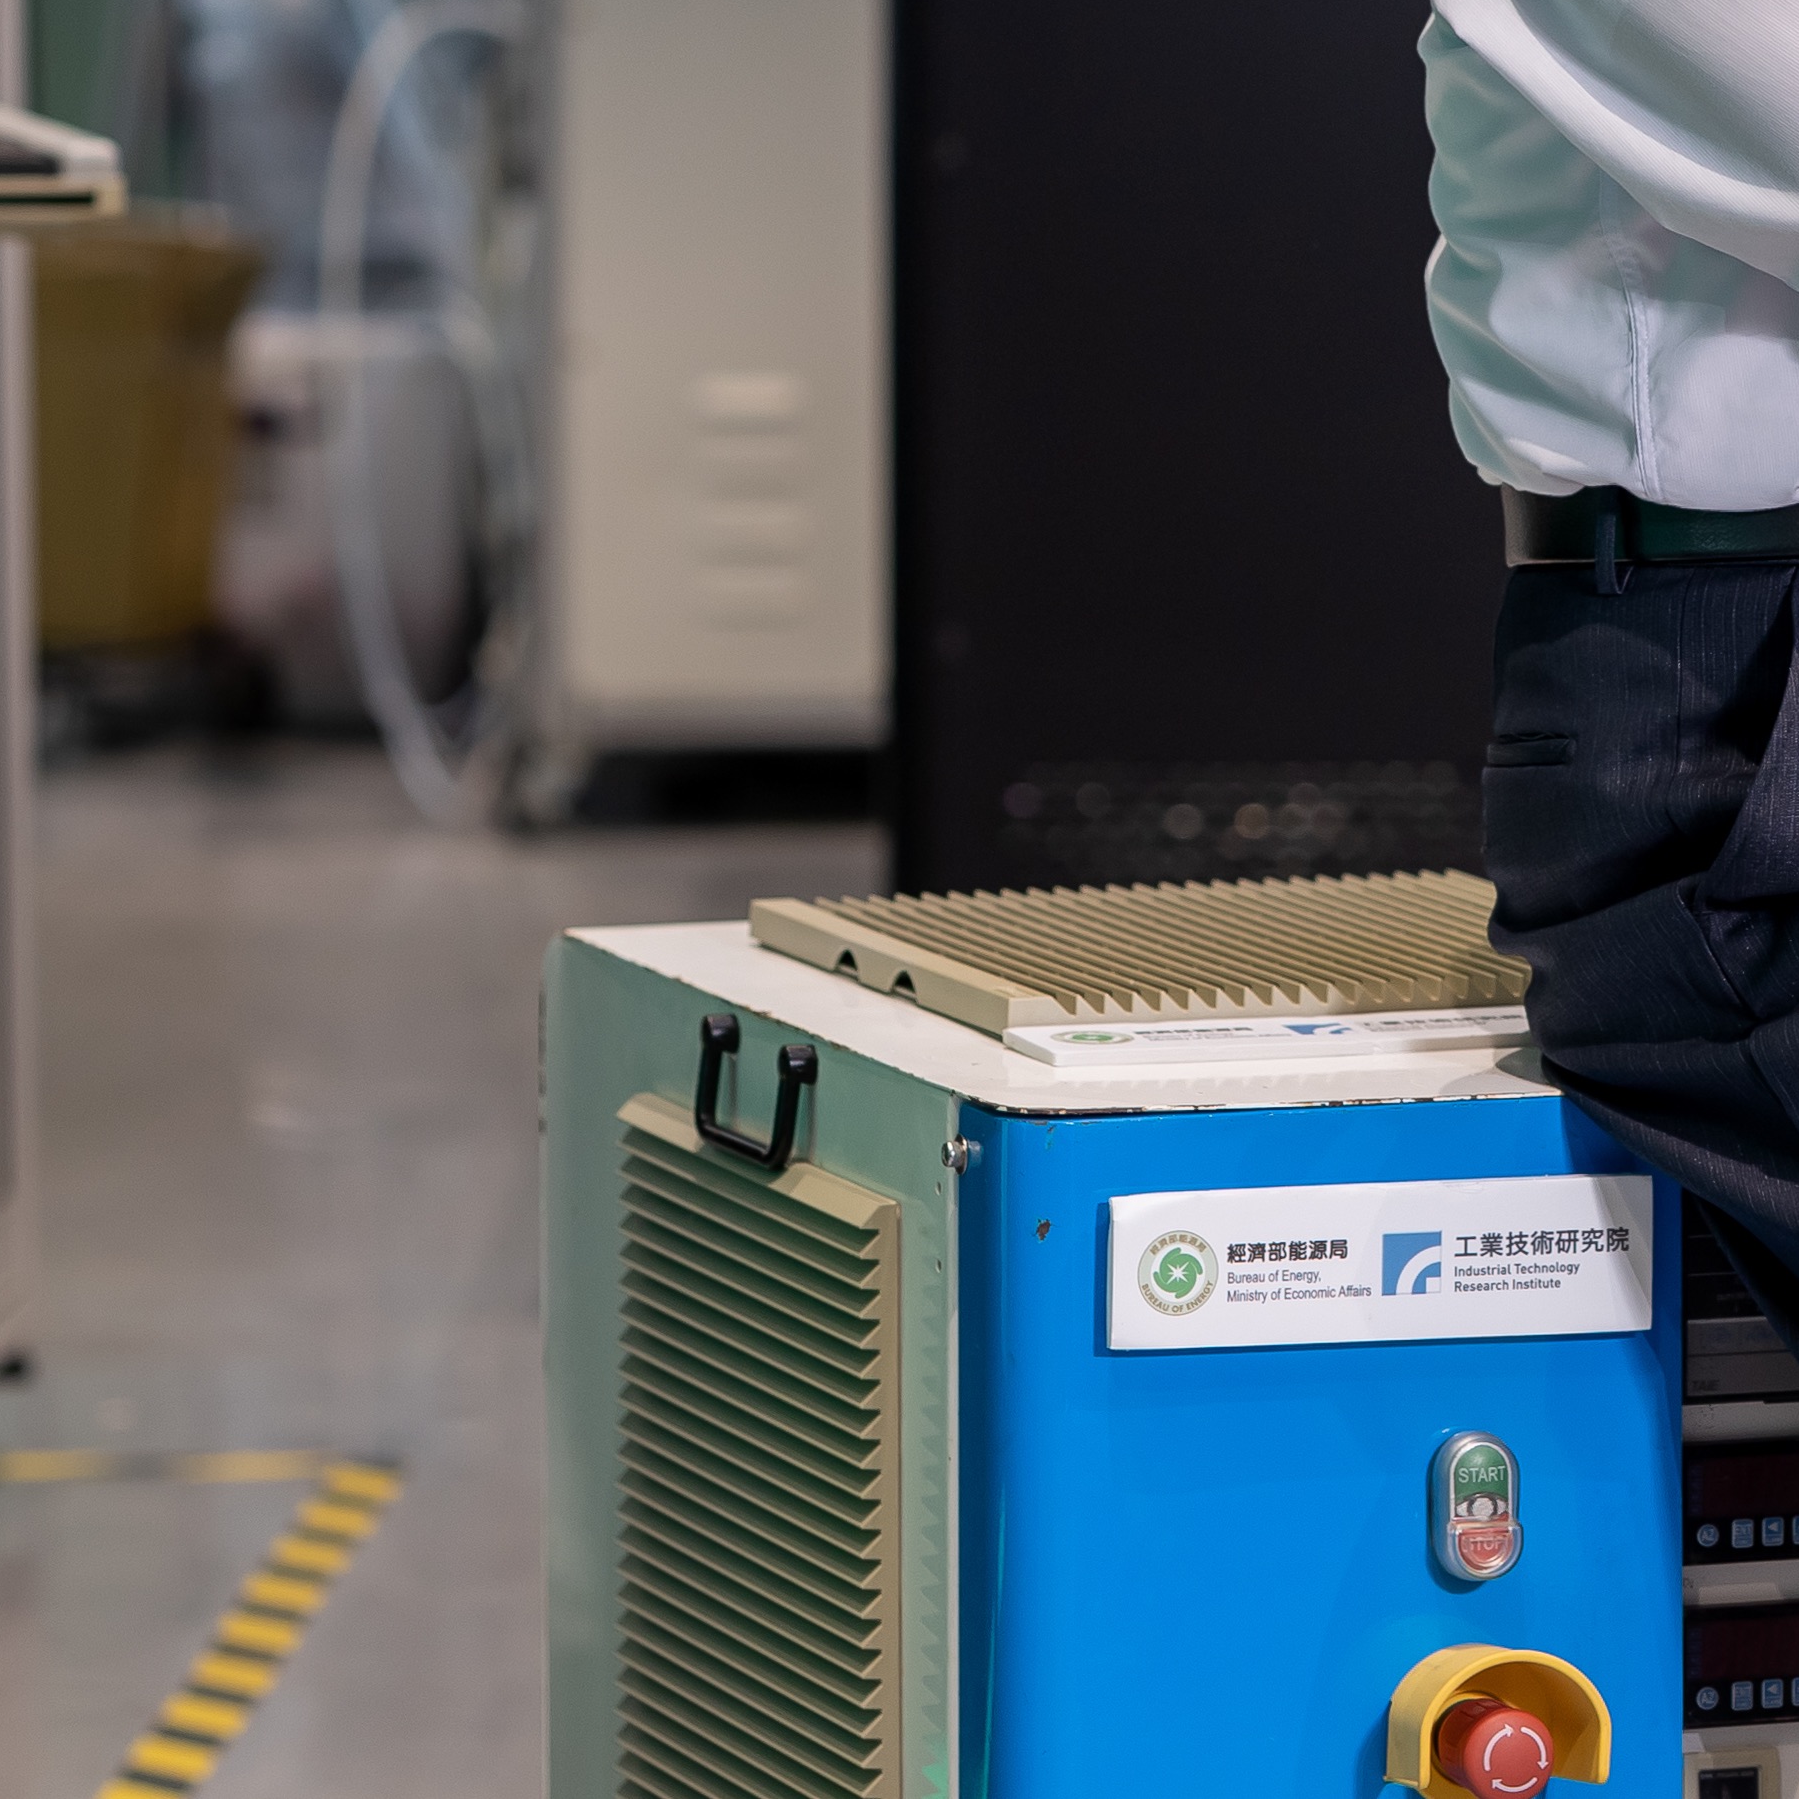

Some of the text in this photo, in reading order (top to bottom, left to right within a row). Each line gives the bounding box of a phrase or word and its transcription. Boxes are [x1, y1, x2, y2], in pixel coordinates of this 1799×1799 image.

[1226, 1239, 1349, 1263] 經濟部能源局
[1454, 1227, 1630, 1257] 工業技術研究院
[1227, 1269, 1321, 1284] Bureau of Energy,
[1454, 1262, 1580, 1277] Industrial Technology
[1226, 1284, 1372, 1304] Ministry of Economic Affairs
[1454, 1278, 1561, 1292] Research Institute
[1142, 1281, 1214, 1313] BUREAU OF ENERGY
[1458, 1465, 1506, 1483] START
